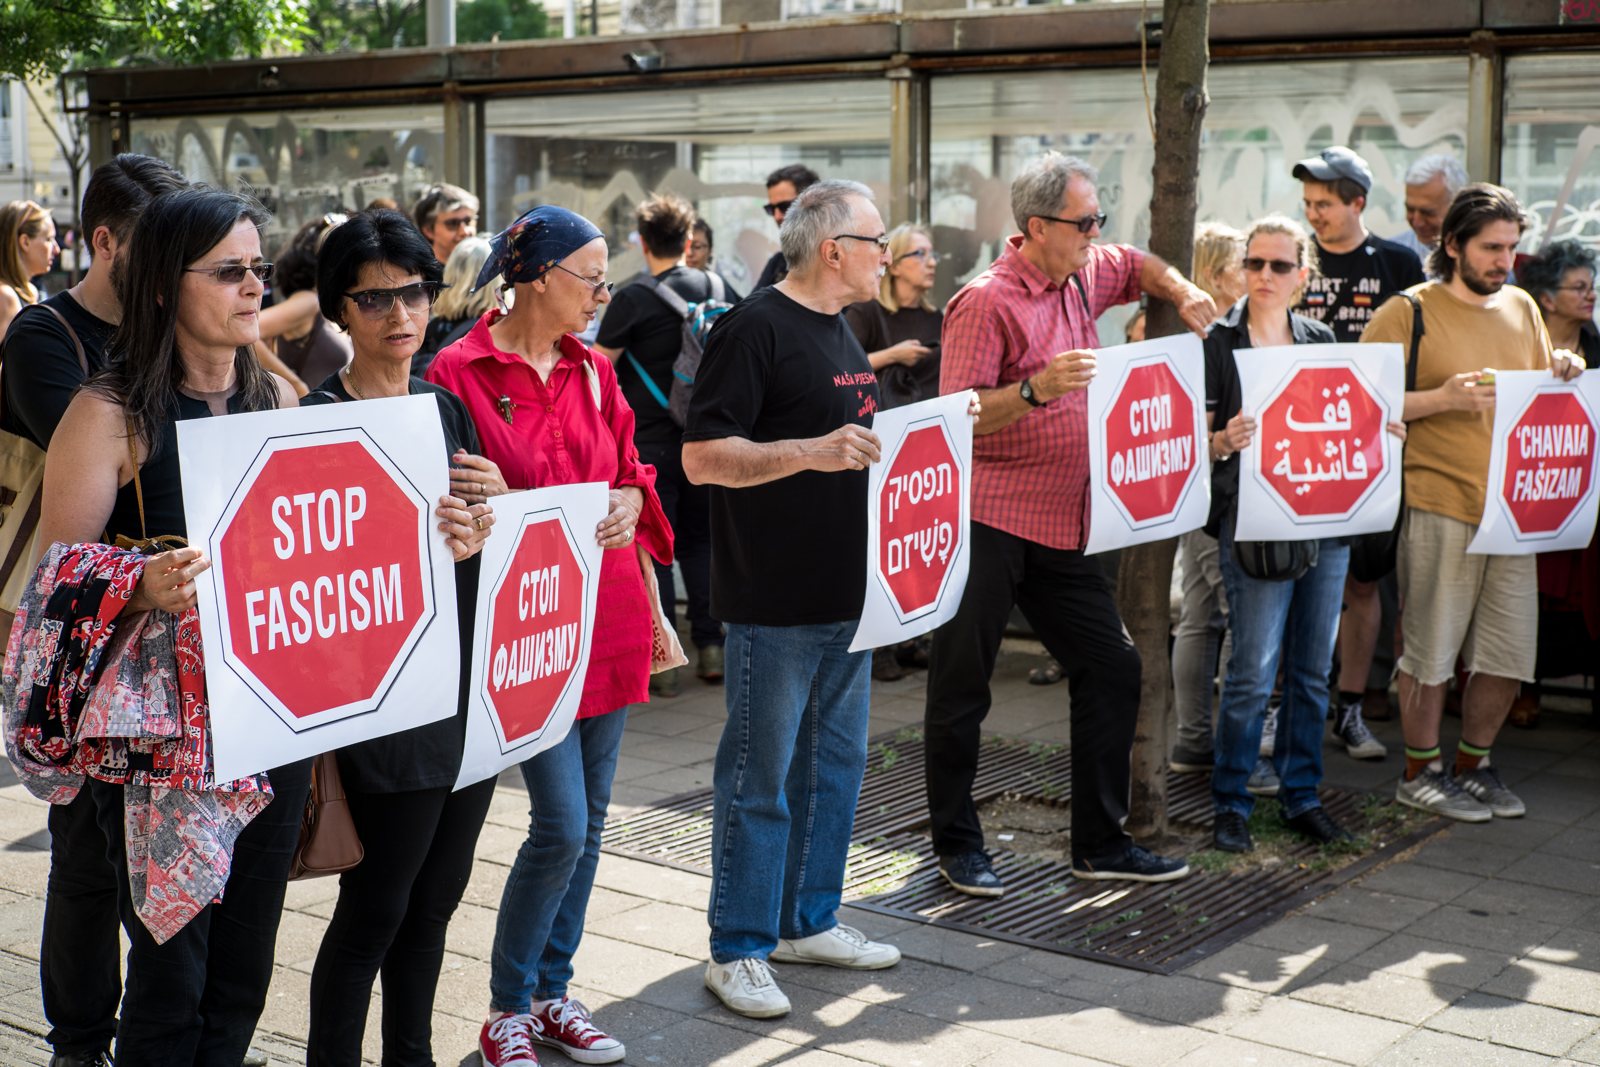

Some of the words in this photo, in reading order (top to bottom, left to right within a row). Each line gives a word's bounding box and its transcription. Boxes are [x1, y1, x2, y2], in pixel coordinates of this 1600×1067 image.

[833, 370, 856, 387] NAŠA
[854, 371, 878, 385] PJESM
[1285, 382, 1352, 432] قف
[1129, 393, 1172, 437] СТОП
[1110, 434, 1192, 488] ФАШИЗМУ
[1272, 437, 1368, 496] فاشية
[1511, 461, 1583, 502] FAŠIZAM
[888, 462, 952, 523] תפסיק
[271, 486, 367, 560] STOP
[245, 563, 404, 655] FASCISM
[518, 564, 560, 622] СТОП
[492, 622, 578, 692] ФАШИЗМУ
